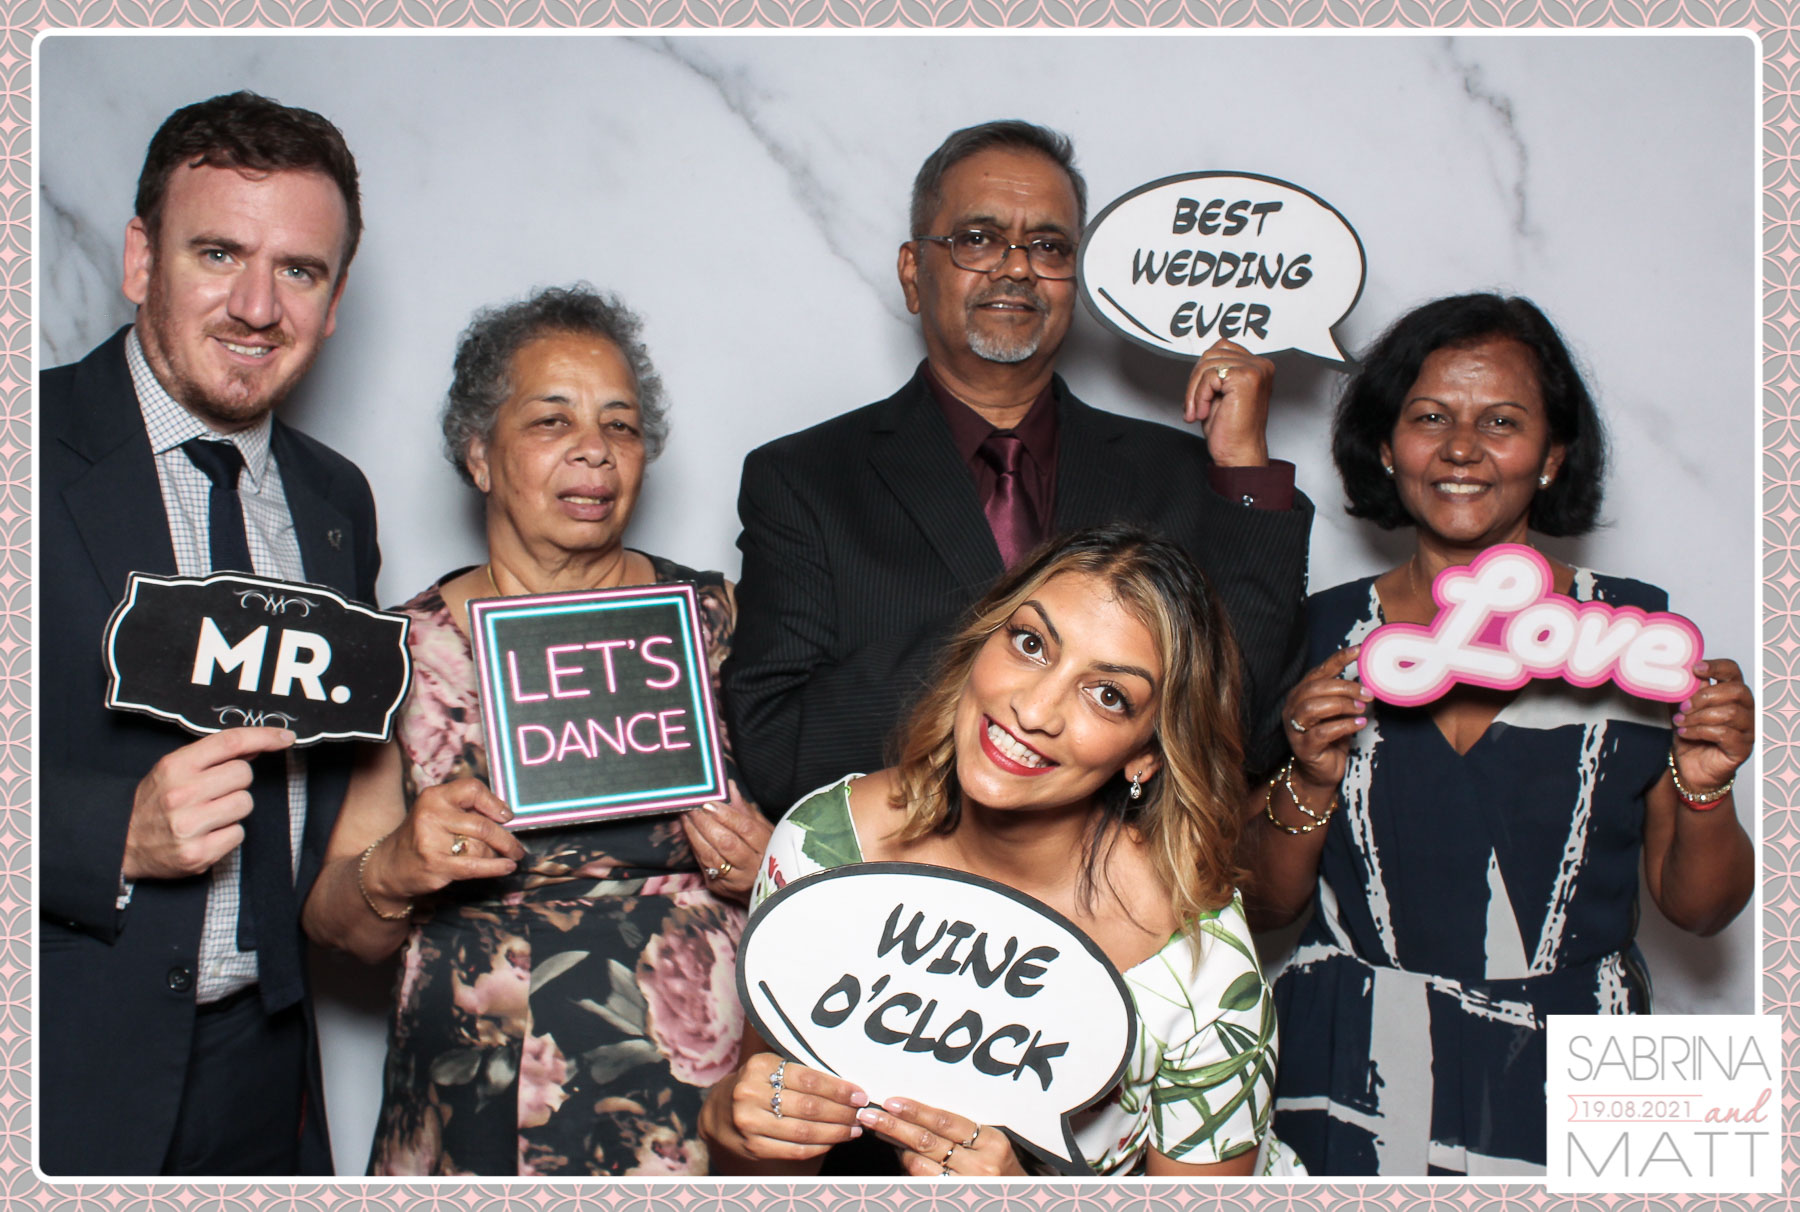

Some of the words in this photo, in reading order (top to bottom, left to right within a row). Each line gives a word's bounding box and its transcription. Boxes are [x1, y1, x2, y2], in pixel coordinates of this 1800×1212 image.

[1172, 197, 1283, 236] BEST
[1132, 248, 1313, 290] WEDDING
[1170, 301, 1271, 340] EVER
[1368, 555, 1693, 696] Love
[190, 615, 352, 704] MR.
[506, 636, 681, 702] LET'S
[516, 708, 692, 766] DANCE
[877, 903, 1060, 998] WINE
[811, 973, 1069, 1091] O'CLOCK
